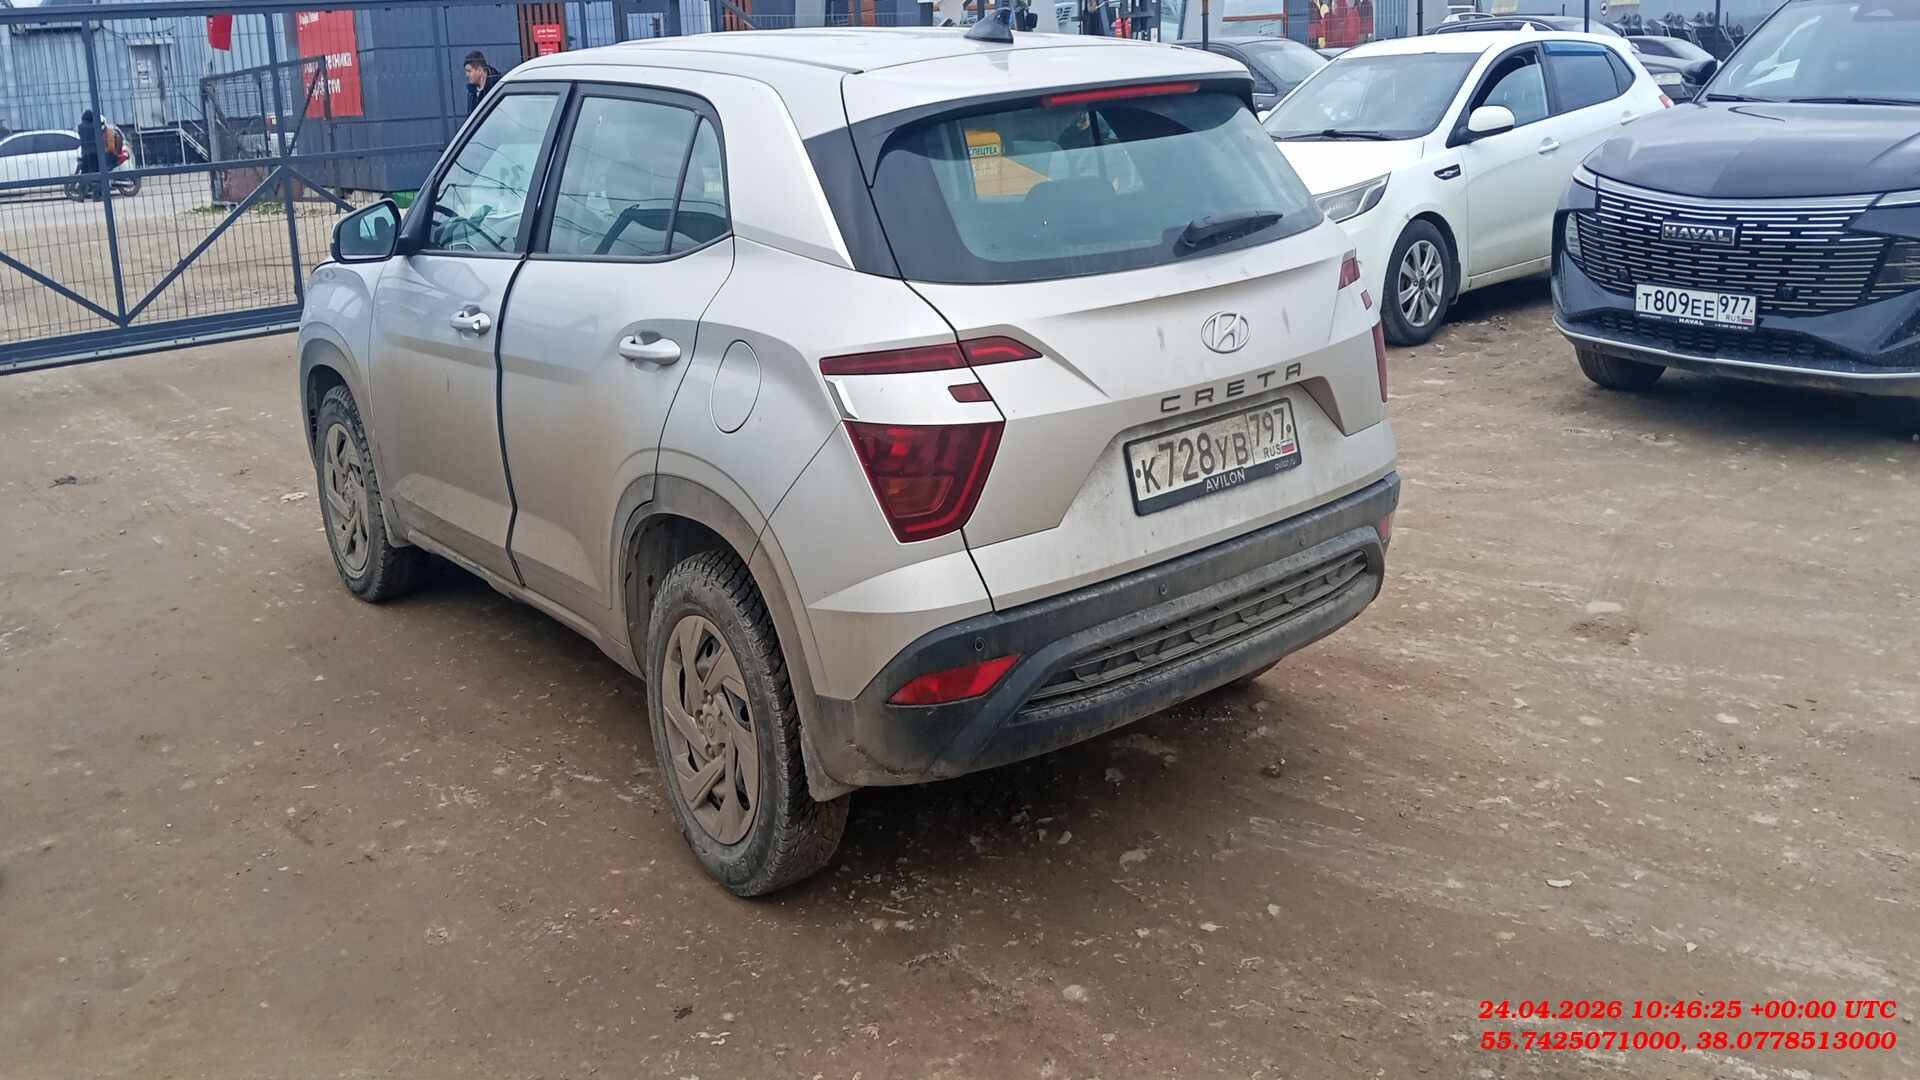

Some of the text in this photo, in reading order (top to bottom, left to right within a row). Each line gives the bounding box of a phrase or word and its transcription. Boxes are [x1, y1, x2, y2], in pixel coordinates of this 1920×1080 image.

[1664, 226, 1730, 242] HAVAL
[1642, 289, 1751, 318] Т809ЕЕ 977
[1679, 317, 1704, 326] HAVAL
[1160, 362, 1302, 413] CRETA
[1141, 407, 1285, 494] К728УВ 797
[1263, 444, 1281, 459] RUS
[1205, 469, 1246, 492] AVILON
